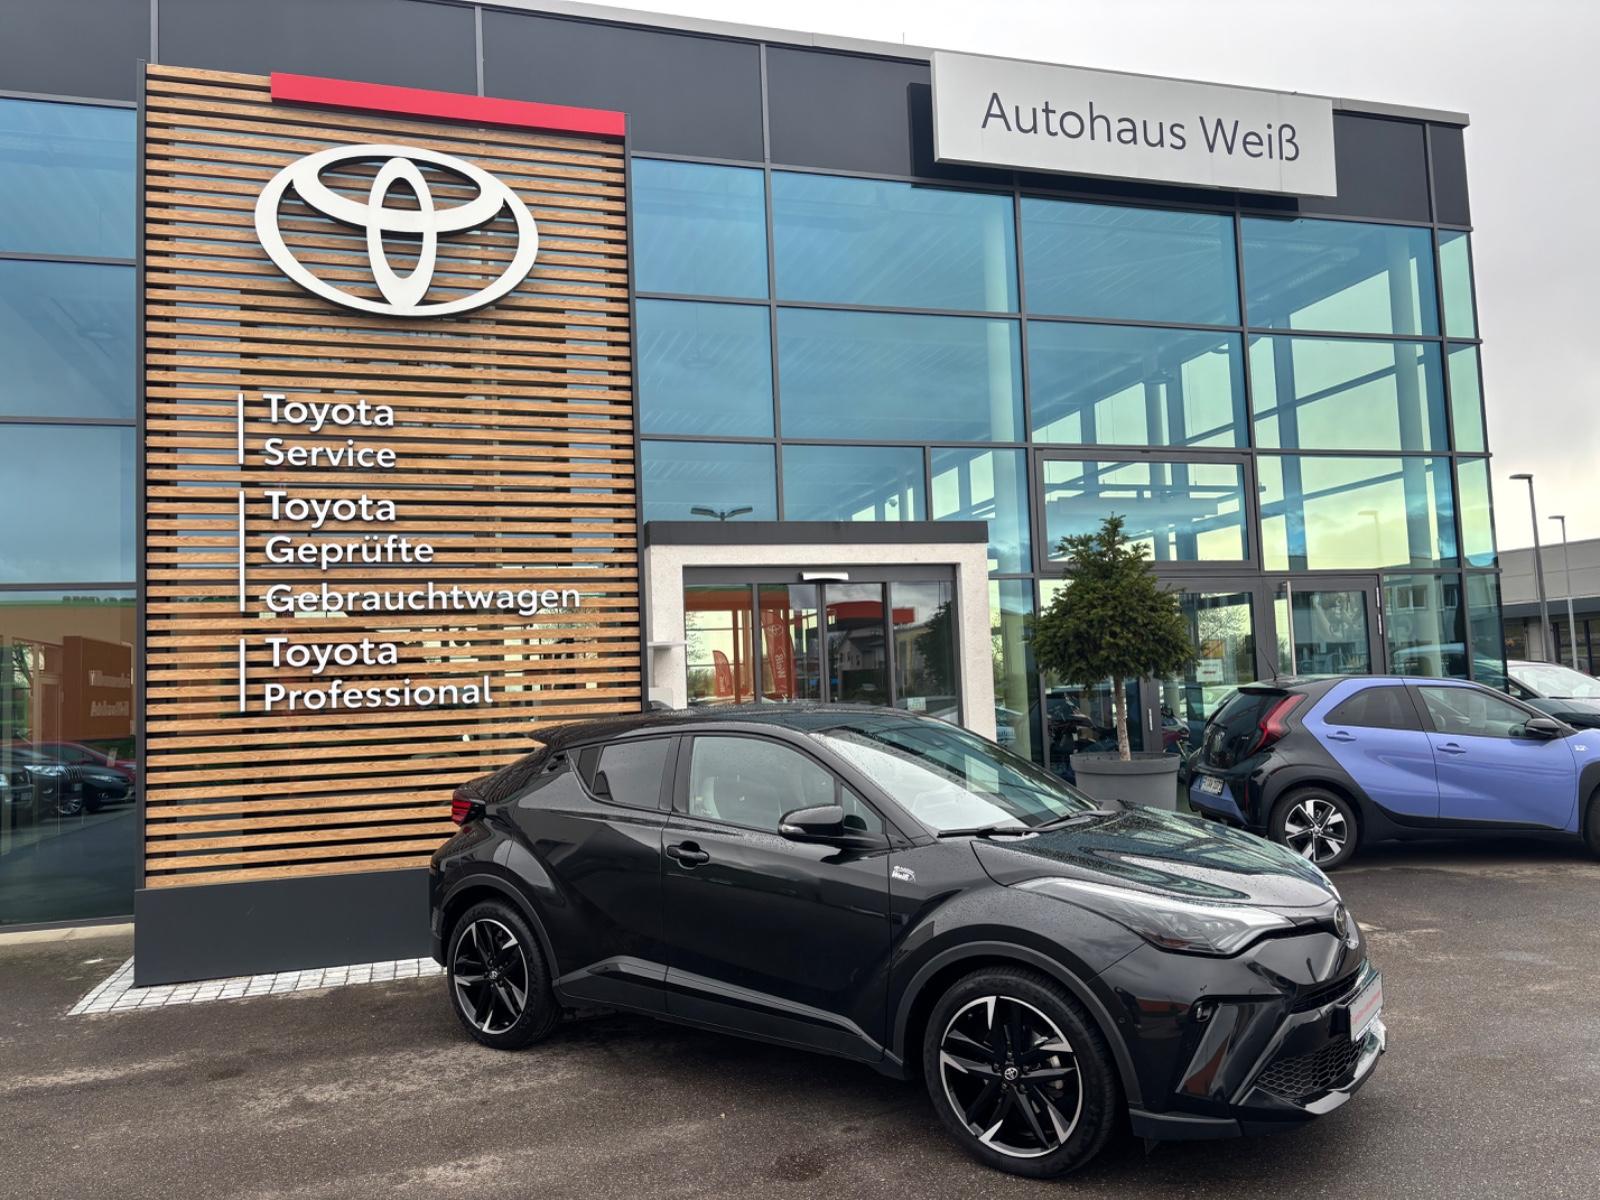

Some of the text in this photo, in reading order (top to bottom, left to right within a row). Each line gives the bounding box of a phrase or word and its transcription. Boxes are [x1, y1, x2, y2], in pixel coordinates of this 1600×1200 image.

[982, 92, 1300, 162] Autohaus Weiß
[263, 393, 395, 433] Toyota
[264, 437, 397, 468] Service
[264, 490, 396, 529] Toyota
[265, 535, 435, 571] Geprüfte
[265, 582, 581, 616] Gebrauchtwagen
[264, 637, 398, 674] Toyota
[264, 675, 494, 711] Professional
